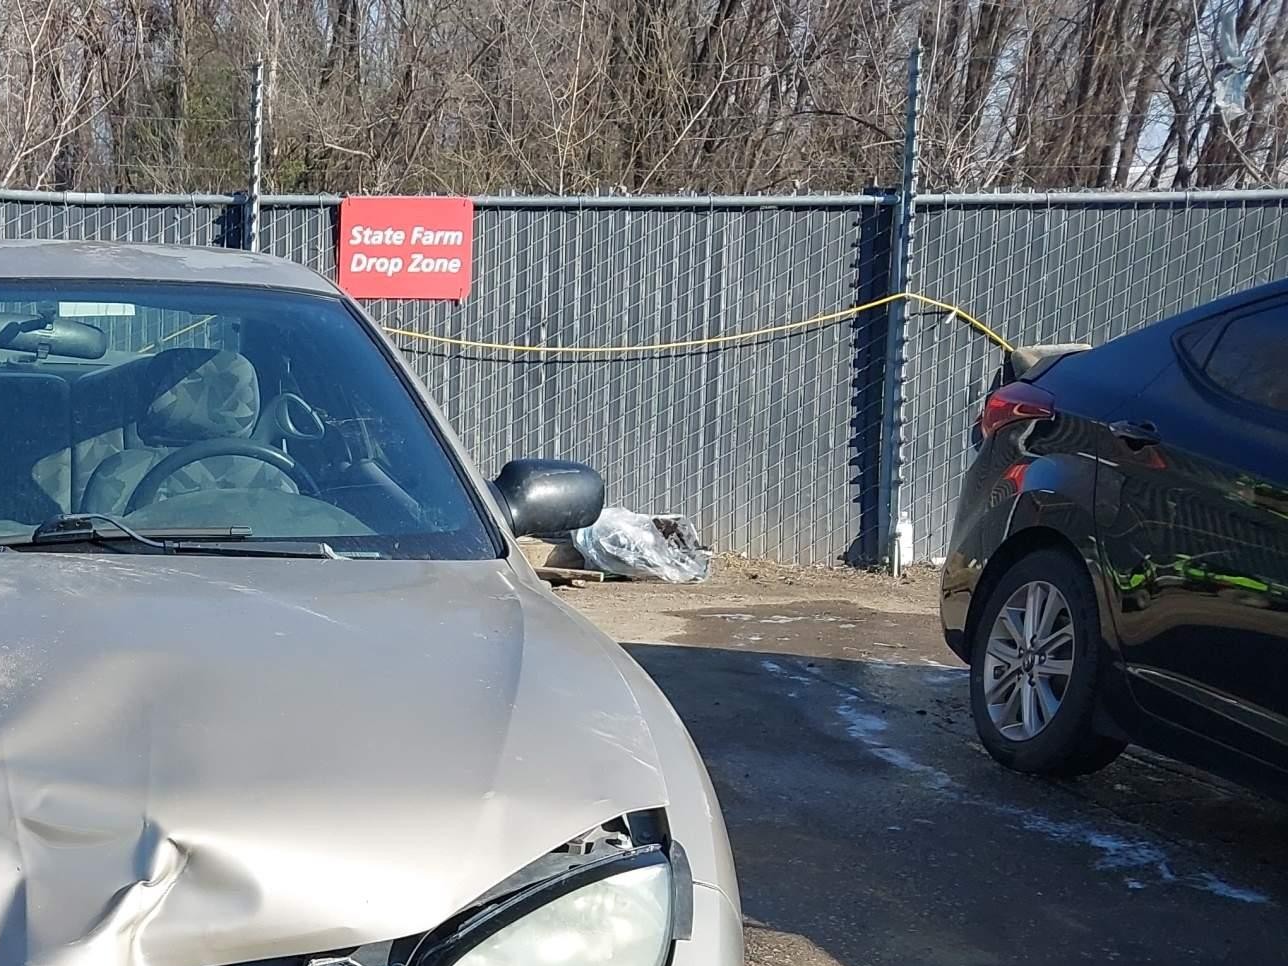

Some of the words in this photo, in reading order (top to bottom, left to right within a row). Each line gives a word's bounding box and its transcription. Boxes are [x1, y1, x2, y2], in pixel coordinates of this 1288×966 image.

[349, 225, 406, 246] State
[410, 226, 464, 246] Farm
[350, 253, 404, 277] Drop
[407, 253, 462, 273] Zone
